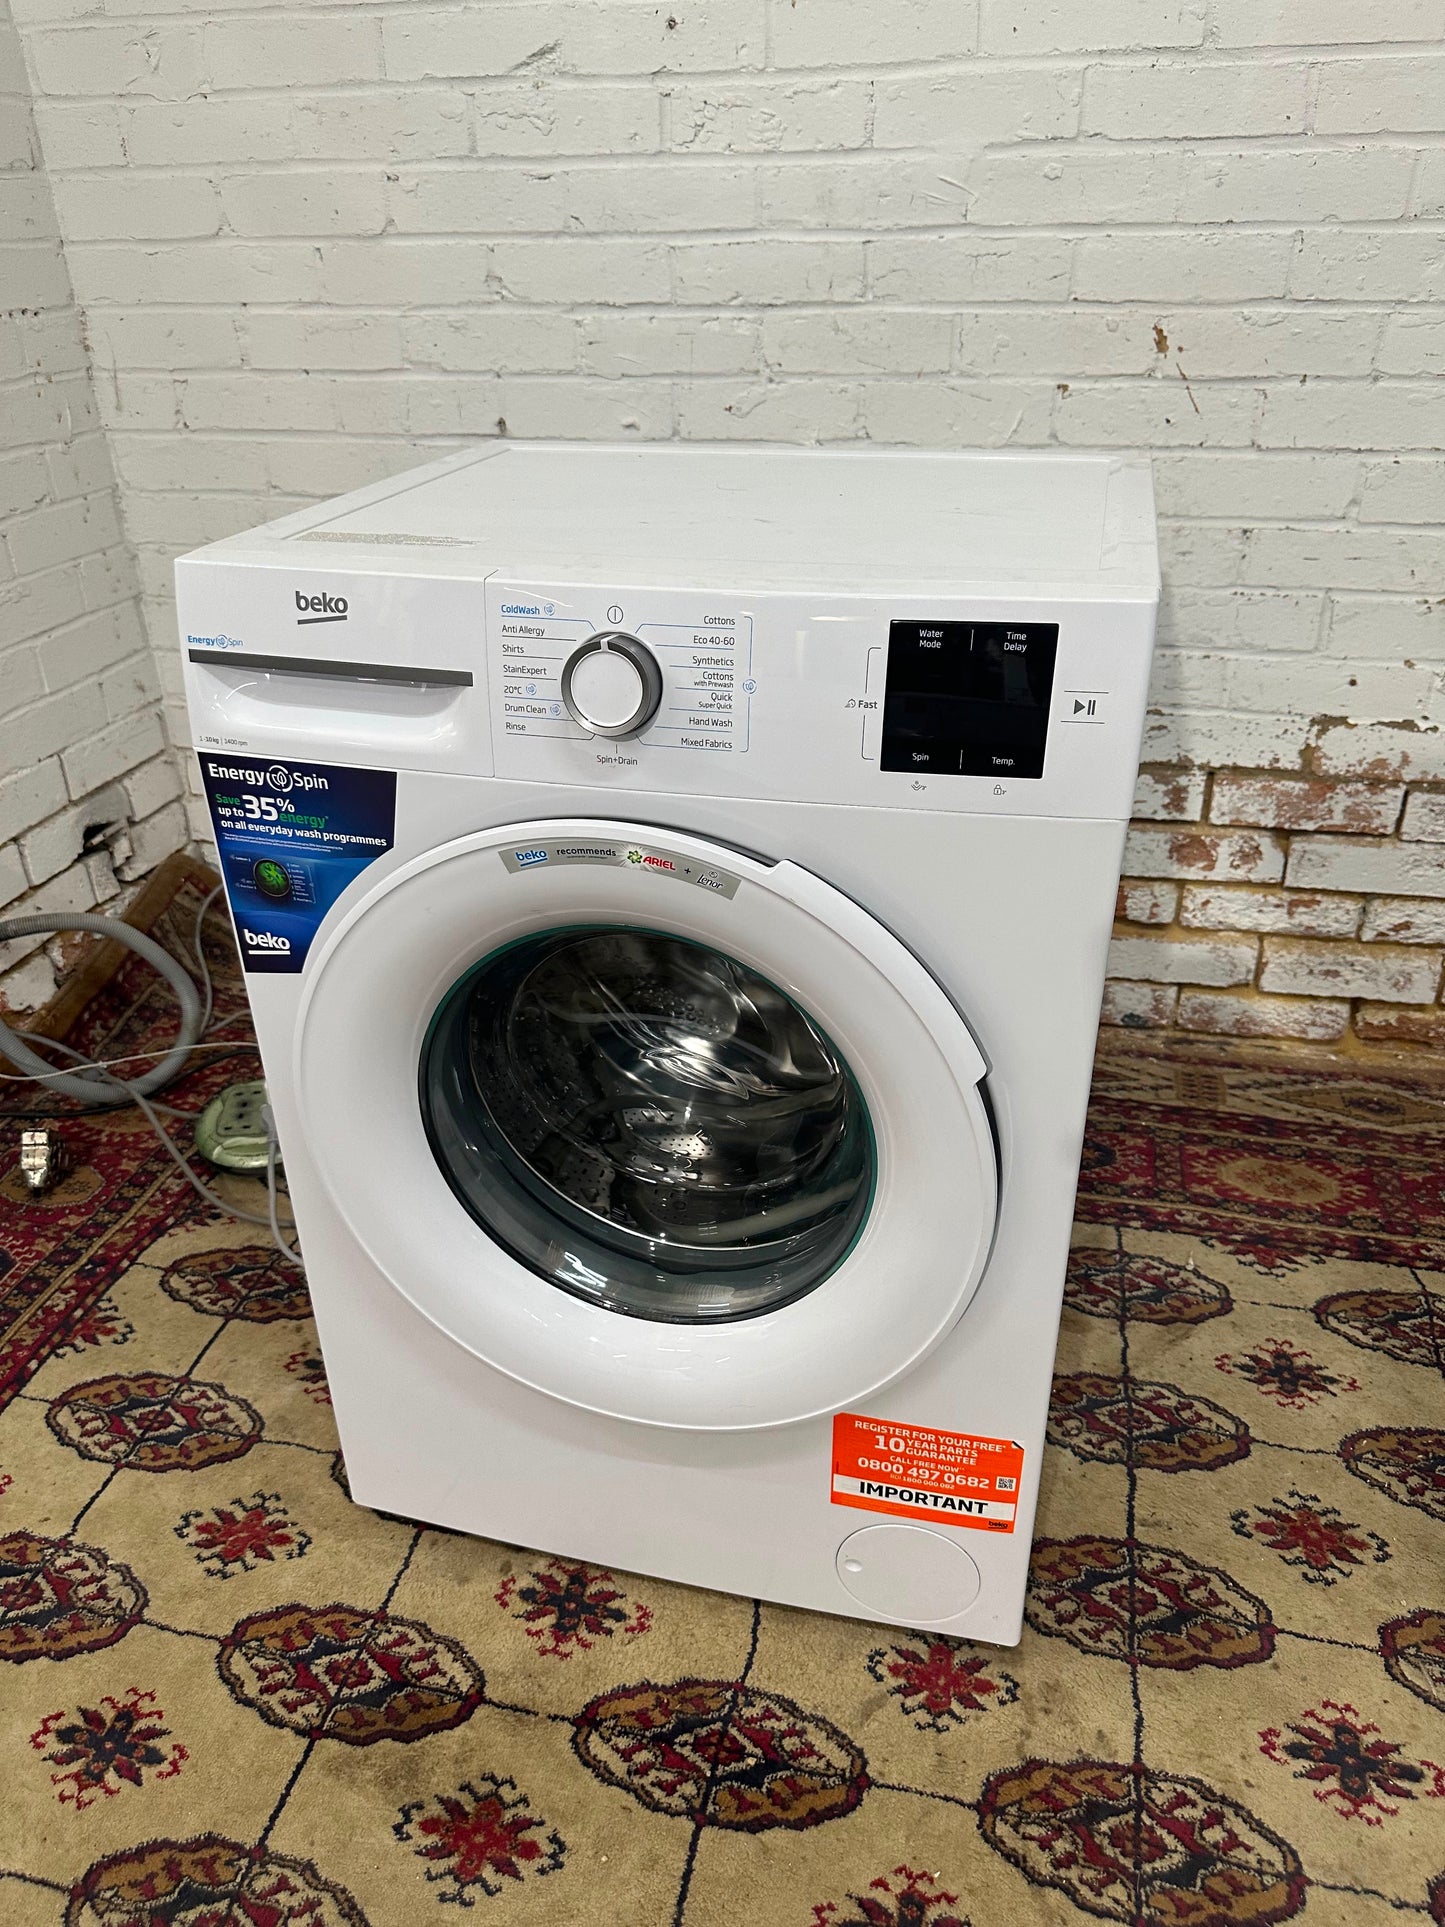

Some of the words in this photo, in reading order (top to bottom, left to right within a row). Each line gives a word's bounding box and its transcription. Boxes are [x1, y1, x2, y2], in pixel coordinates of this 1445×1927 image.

[296, 591, 348, 613] beko
[501, 605, 540, 615] ColdWash
[704, 616, 735, 625] Cottons
[502, 625, 518, 634] Anti
[519, 626, 545, 636] Allergy
[919, 630, 943, 638] Water
[188, 635, 215, 645] Energy
[228, 638, 243, 646] Spin
[693, 636, 707, 645] Eco
[709, 636, 735, 645] 40-60
[1006, 632, 1026, 640] Time
[503, 645, 524, 653] Shirts
[920, 640, 941, 649] Mode
[1004, 642, 1027, 652] Delay
[692, 656, 734, 667] Synthetics
[504, 665, 547, 675] StainExpert
[703, 672, 733, 681] Cottons
[708, 681, 733, 689] Prewash
[504, 686, 522, 695] 20°C
[711, 692, 732, 702] Quick
[505, 704, 525, 713] Drum
[526, 705, 546, 714] Clean
[698, 702, 716, 710] Super
[858, 700, 877, 709] Fast
[506, 722, 526, 731] Rinse
[689, 718, 709, 727] Hand
[711, 719, 732, 728] Wash
[681, 738, 703, 748] Mixed
[705, 740, 732, 749] Fabrics
[597, 755, 637, 765] Spin+Drain
[912, 753, 929, 761] Spin
[992, 757, 1015, 766] Temp.
[208, 763, 264, 786] Energy
[293, 774, 329, 790] Spin
[215, 794, 240, 805] Save
[218, 807, 231, 817] up
[233, 808, 244, 817] to
[221, 820, 234, 828] on
[235, 821, 247, 829] all
[248, 823, 293, 837] everyday
[295, 829, 321, 839] wash
[323, 833, 387, 846] programmes
[516, 850, 546, 861] beko
[557, 848, 616, 857] recommends
[643, 856, 676, 870] ARIEL
[697, 874, 723, 890] Lenor
[243, 929, 290, 950] beko
[855, 1420, 910, 1437] REGISTER
[912, 1432, 935, 1442] FOR
[938, 1436, 971, 1448] YOUR
[874, 1435, 905, 1453] 10
[906, 1439, 938, 1451] YEAR
[940, 1445, 978, 1457] PARTS
[906, 1447, 976, 1466] GUARANTEE
[890, 1456, 912, 1465] CALL
[913, 1459, 936, 1469] FREE
[857, 1457, 903, 1474] 0800
[907, 1467, 940, 1480] 497
[944, 1473, 990, 1489] 0682
[860, 1482, 988, 1514] IMPORTANT
